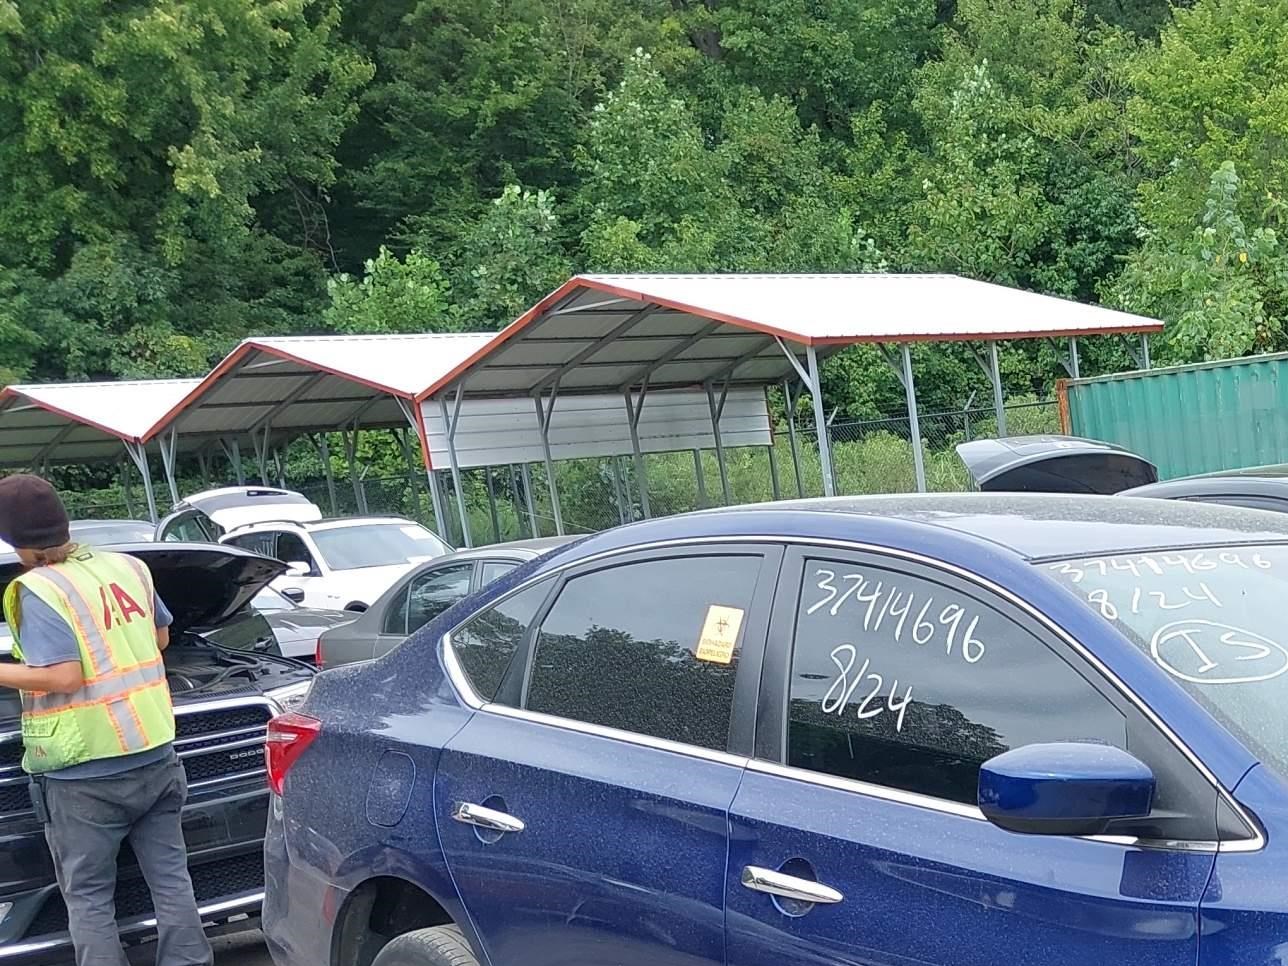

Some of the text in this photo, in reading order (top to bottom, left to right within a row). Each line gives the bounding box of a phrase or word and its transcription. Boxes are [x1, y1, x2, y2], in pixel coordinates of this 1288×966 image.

[807, 569, 986, 664] 37414696
[822, 643, 913, 733] 8/24
[230, 748, 264, 760] DODG
